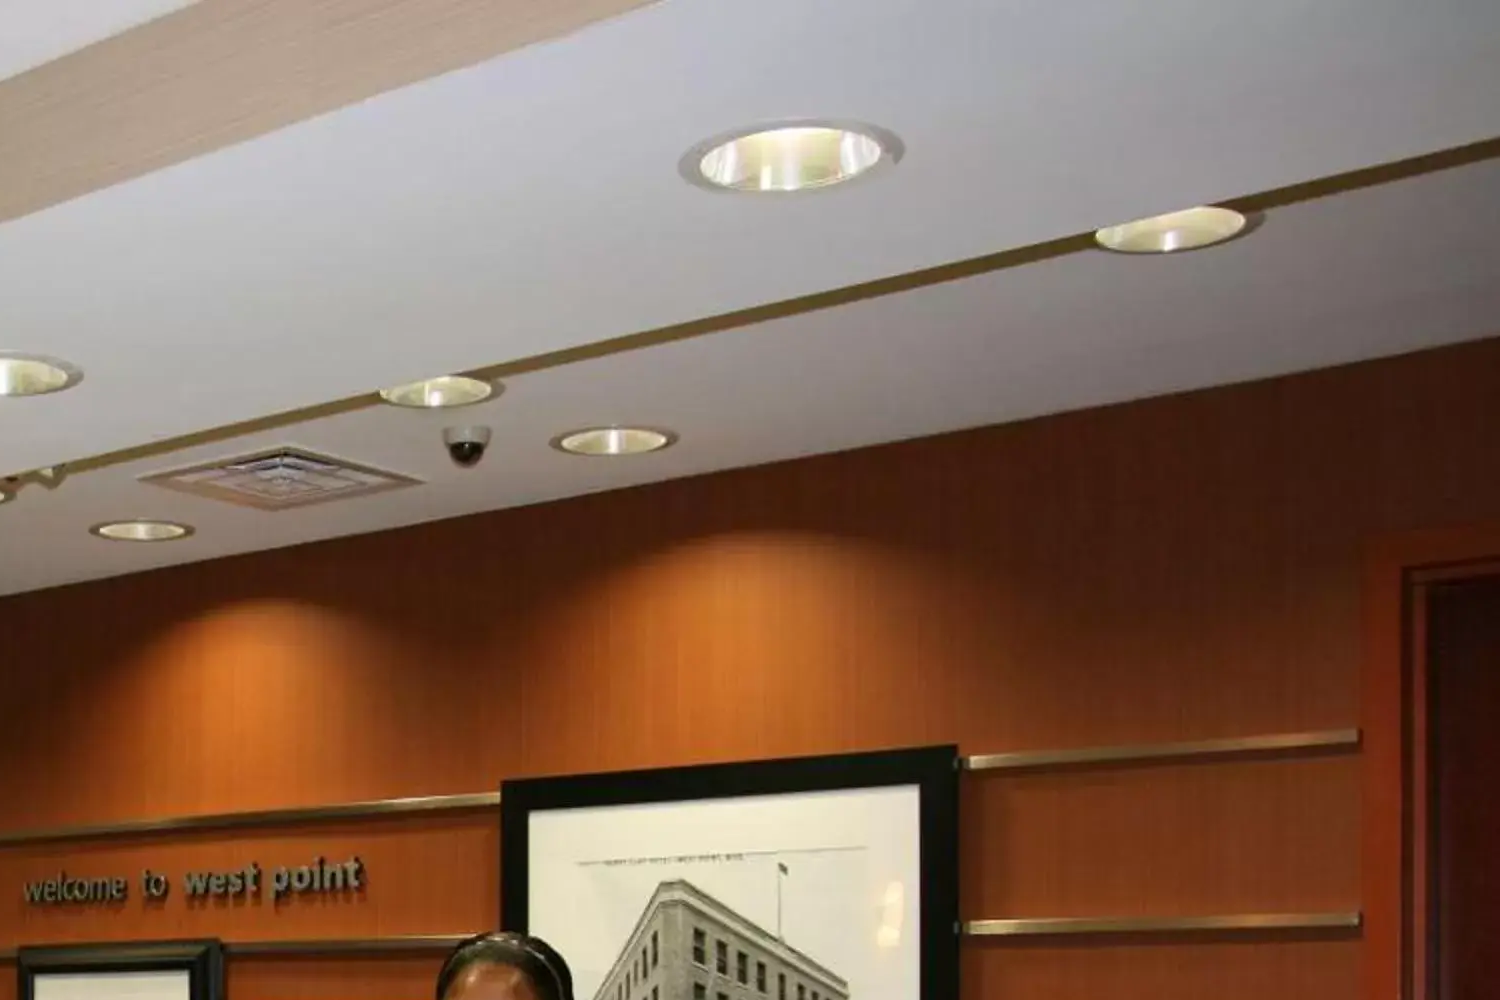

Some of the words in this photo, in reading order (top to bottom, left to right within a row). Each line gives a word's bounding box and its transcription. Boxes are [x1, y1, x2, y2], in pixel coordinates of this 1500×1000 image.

[23, 870, 127, 901] welcome
[143, 869, 169, 897] to
[184, 862, 260, 895] west
[272, 856, 362, 900] point
